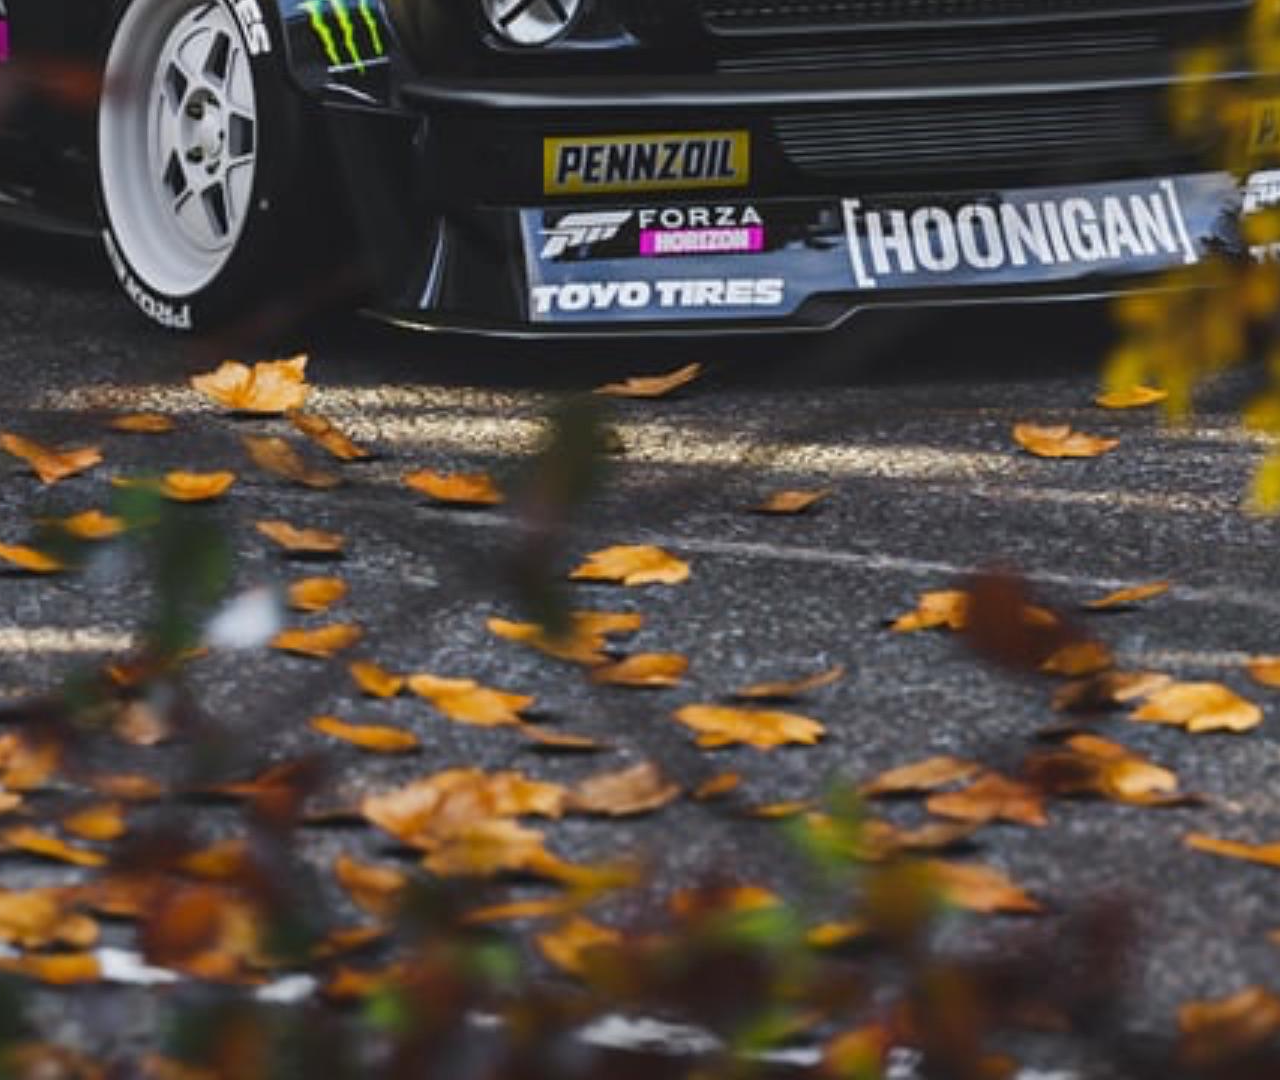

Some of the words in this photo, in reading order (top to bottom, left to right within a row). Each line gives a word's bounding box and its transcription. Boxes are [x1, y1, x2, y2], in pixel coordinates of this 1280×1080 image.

[557, 139, 737, 185] PENNZOIL
[639, 206, 763, 228] FORZA
[102, 227, 192, 329] PROX
[531, 281, 650, 314] TOYO
[654, 277, 785, 309] TIRES
